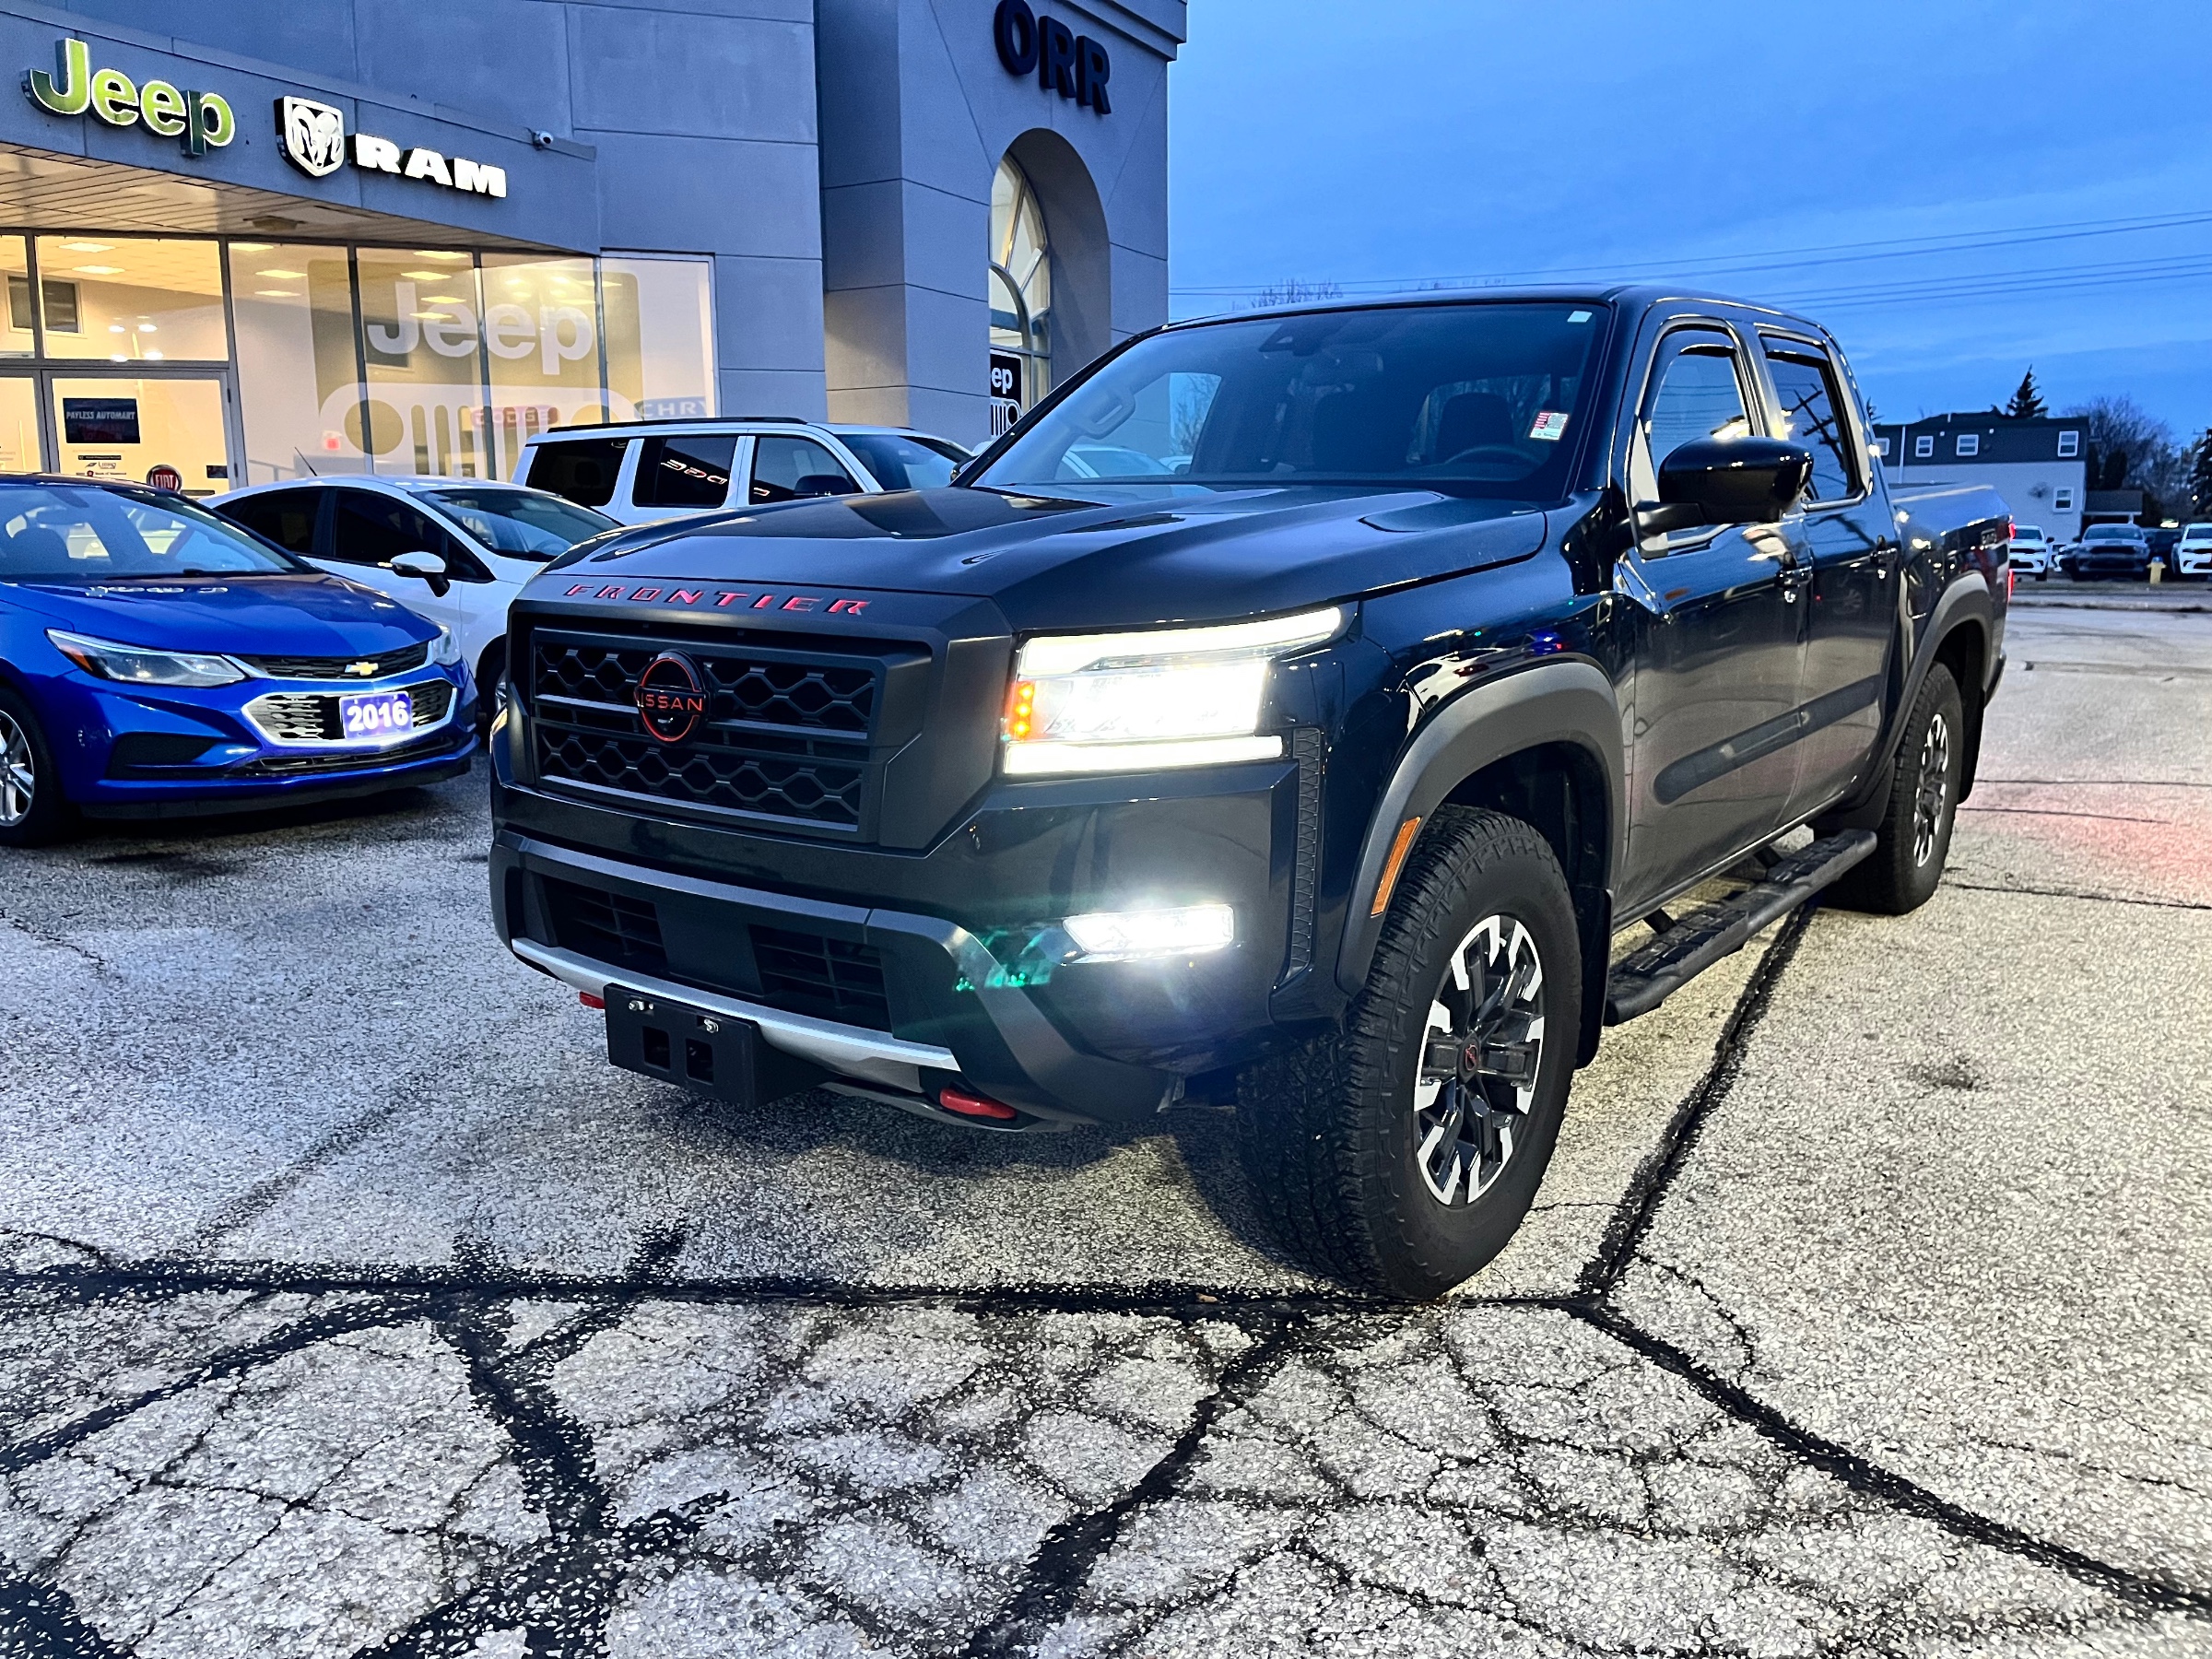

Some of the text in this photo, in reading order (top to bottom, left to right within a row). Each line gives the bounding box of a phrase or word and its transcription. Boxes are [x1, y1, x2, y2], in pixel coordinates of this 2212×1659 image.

[994, 0, 1112, 114] ORR
[24, 37, 236, 157] Jeep
[348, 132, 508, 199] RAM
[367, 281, 594, 376] Jeep
[991, 367, 1014, 394] ep
[66, 411, 135, 420] PAYLESS AUTOMART
[155, 474, 174, 489] FIAT
[564, 583, 871, 615] FRONTIER
[347, 700, 409, 732] 2016
